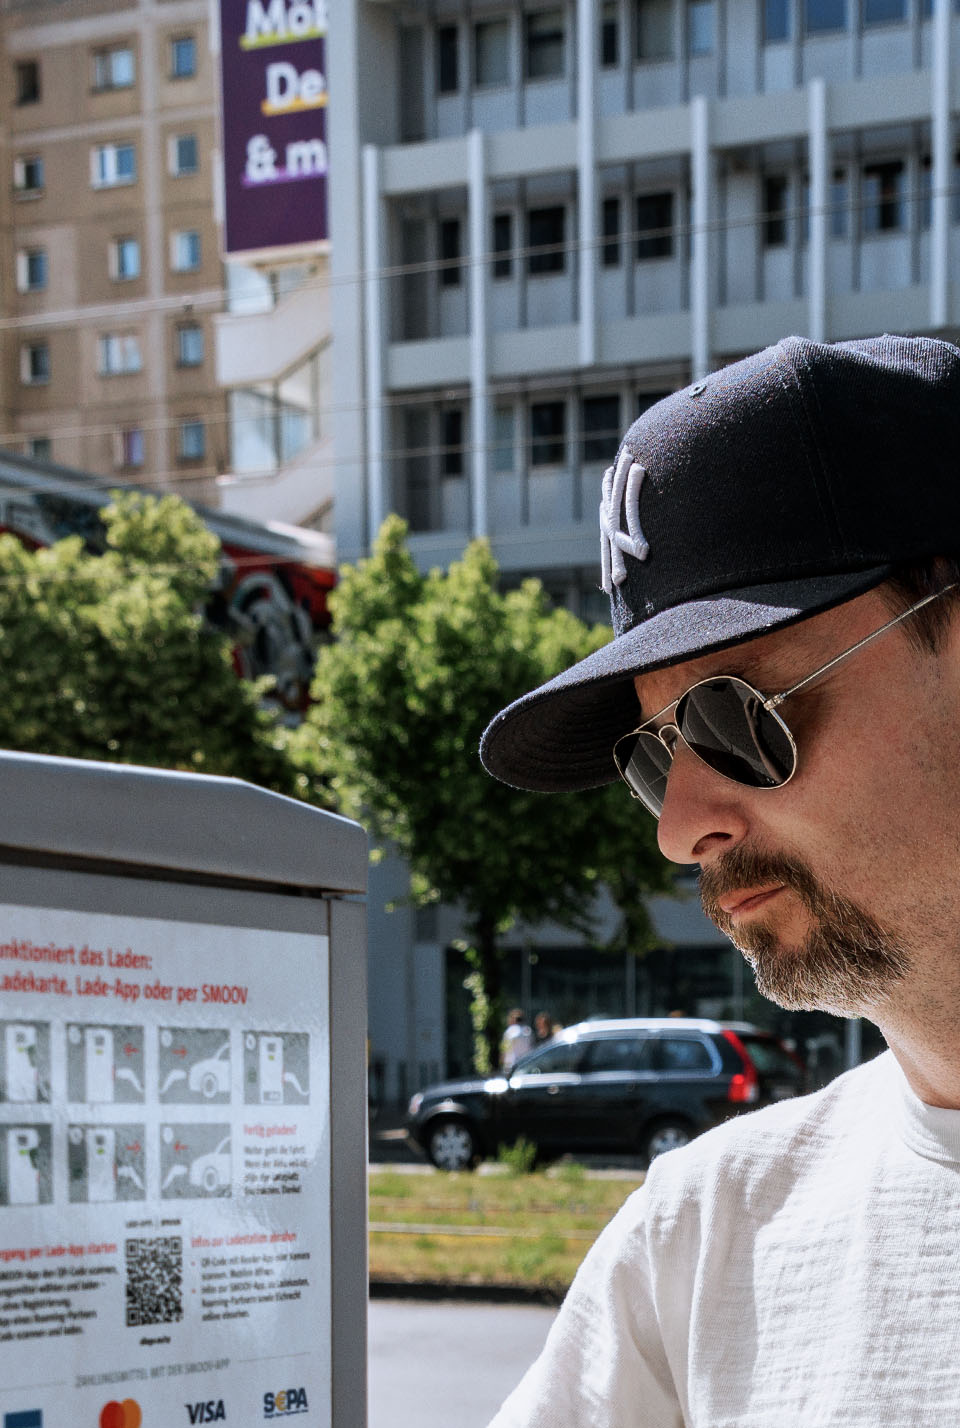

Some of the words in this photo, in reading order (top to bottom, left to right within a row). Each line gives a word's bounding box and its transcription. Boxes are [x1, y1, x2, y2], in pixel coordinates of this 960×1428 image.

[266, 62, 325, 108] De
[246, 133, 277, 181] &
[79, 943, 104, 967] das
[107, 946, 152, 971] Laden:
[0, 970, 72, 997] adekarte,
[75, 974, 140, 1002] Lade-App
[144, 980, 172, 1000] oder
[177, 987, 197, 1004] per
[202, 984, 248, 1005] SMOOV
[184, 1399, 226, 1426] VISA
